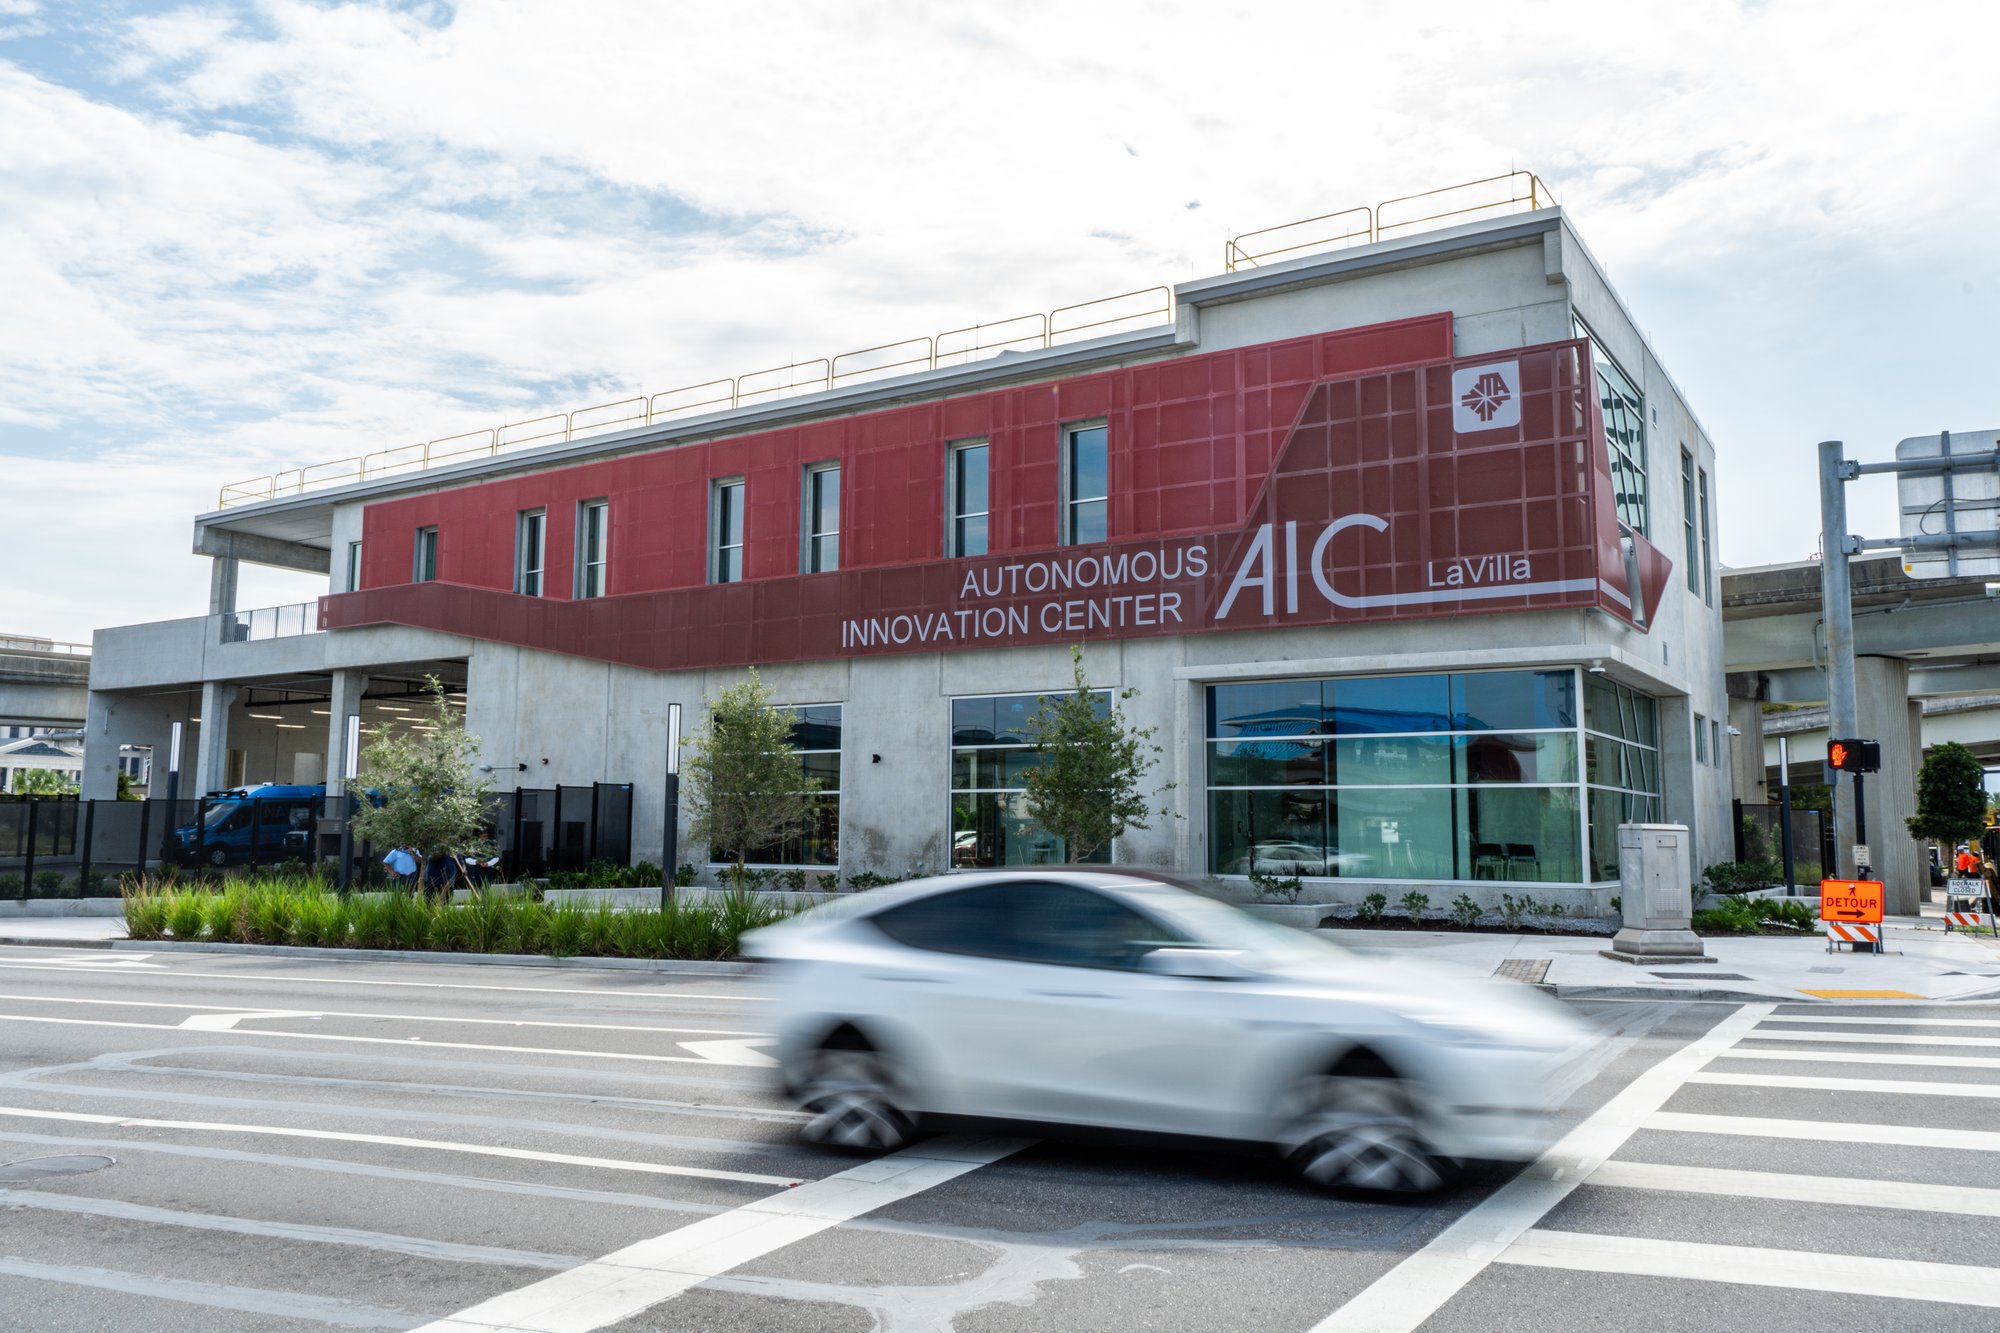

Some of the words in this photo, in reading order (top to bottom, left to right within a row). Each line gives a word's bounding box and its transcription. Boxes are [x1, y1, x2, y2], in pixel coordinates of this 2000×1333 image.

[959, 545, 1209, 599] AUTONOMOUS
[1214, 513, 1390, 620] AIC
[1427, 554, 1532, 588] LaVilla
[841, 605, 1029, 648] INNOVATION
[1039, 591, 1183, 634] CENTER
[1826, 897, 1877, 909] DETOUR
